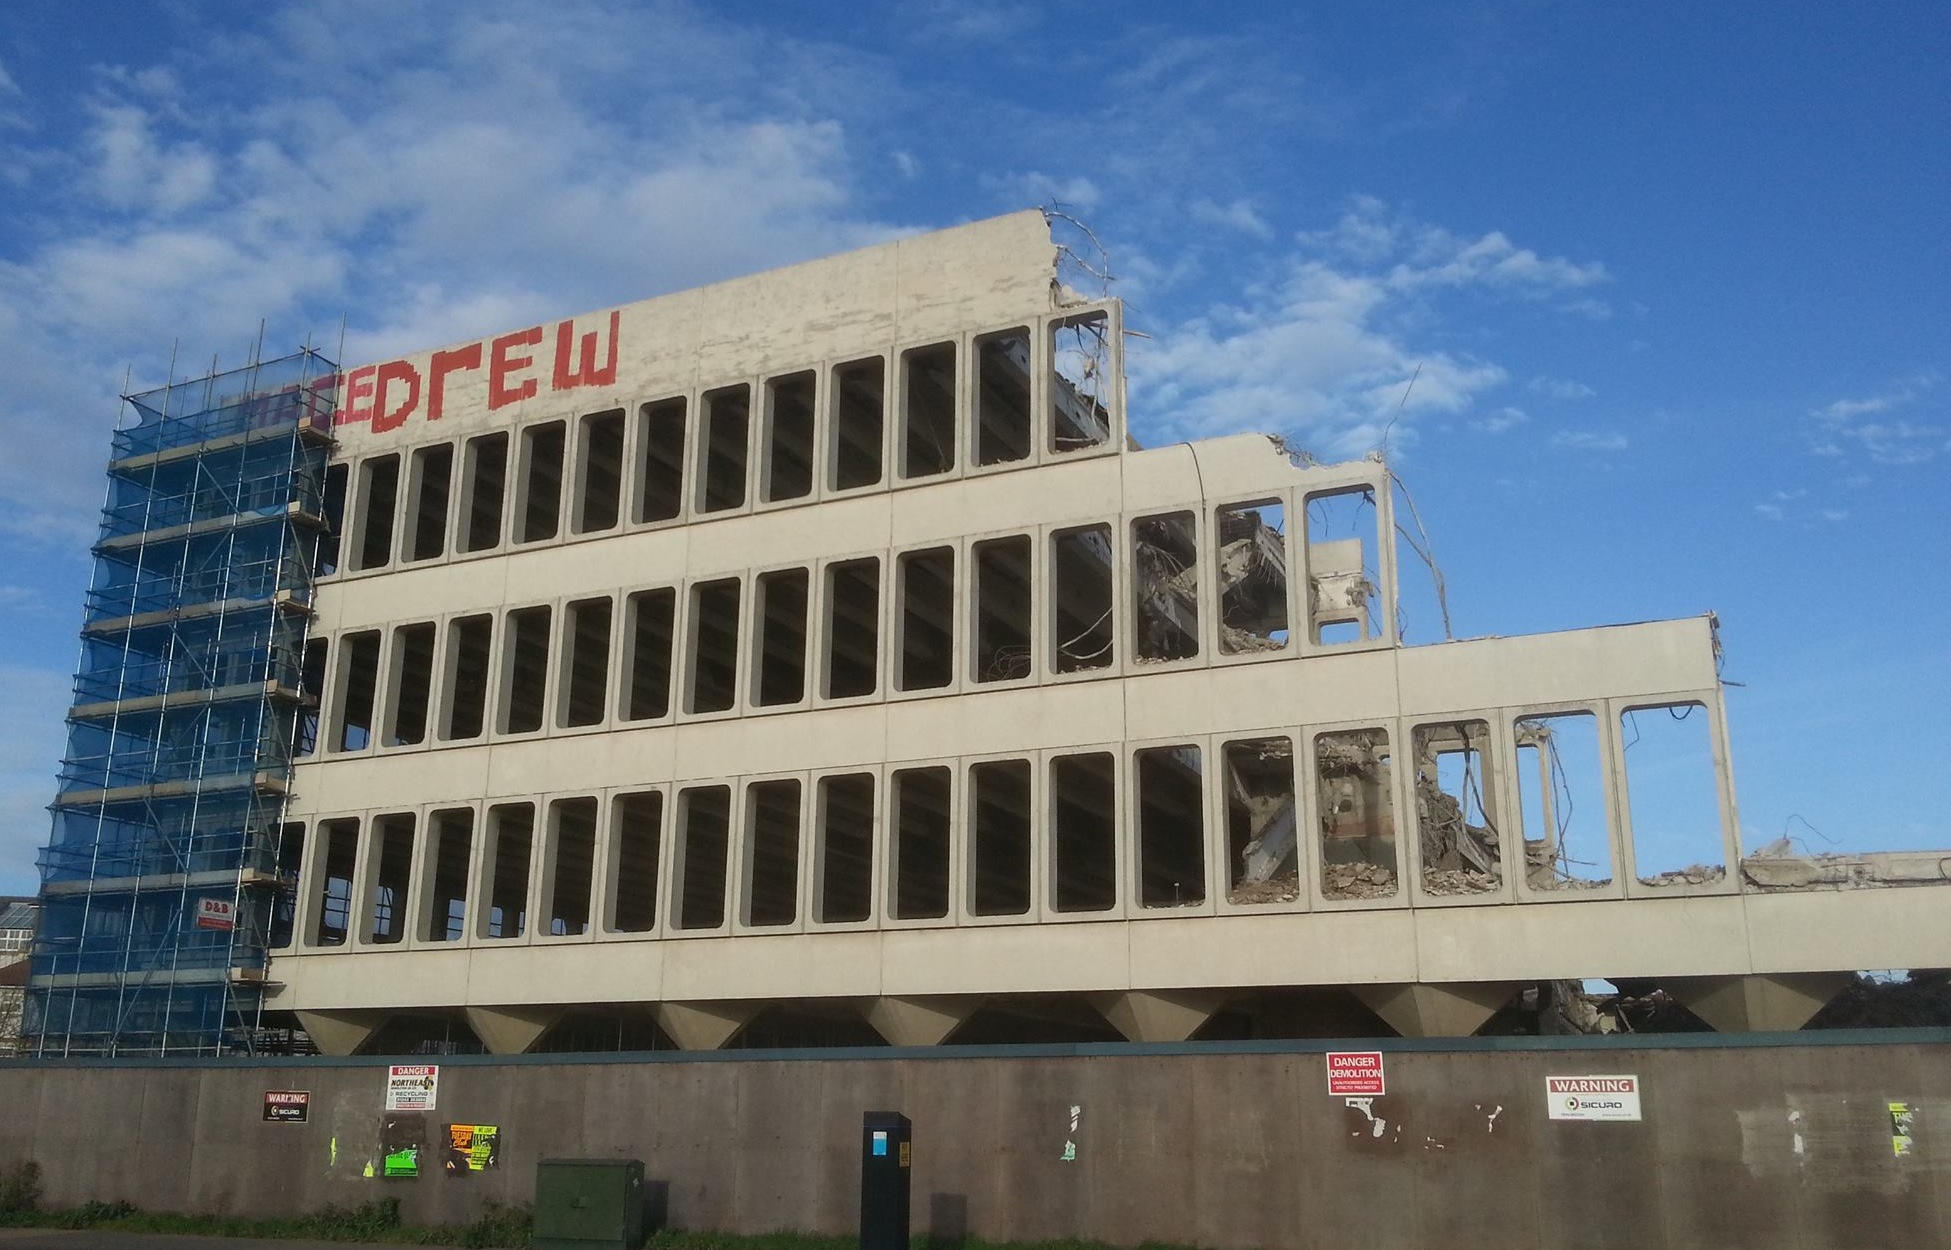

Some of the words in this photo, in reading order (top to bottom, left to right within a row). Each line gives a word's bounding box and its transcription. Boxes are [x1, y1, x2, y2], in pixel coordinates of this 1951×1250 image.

[1334, 1057, 1375, 1067] DANGER
[398, 1067, 429, 1075] DANGER
[1330, 1069, 1381, 1078] DEMOLITION
[1555, 1080, 1630, 1092] WARNING
